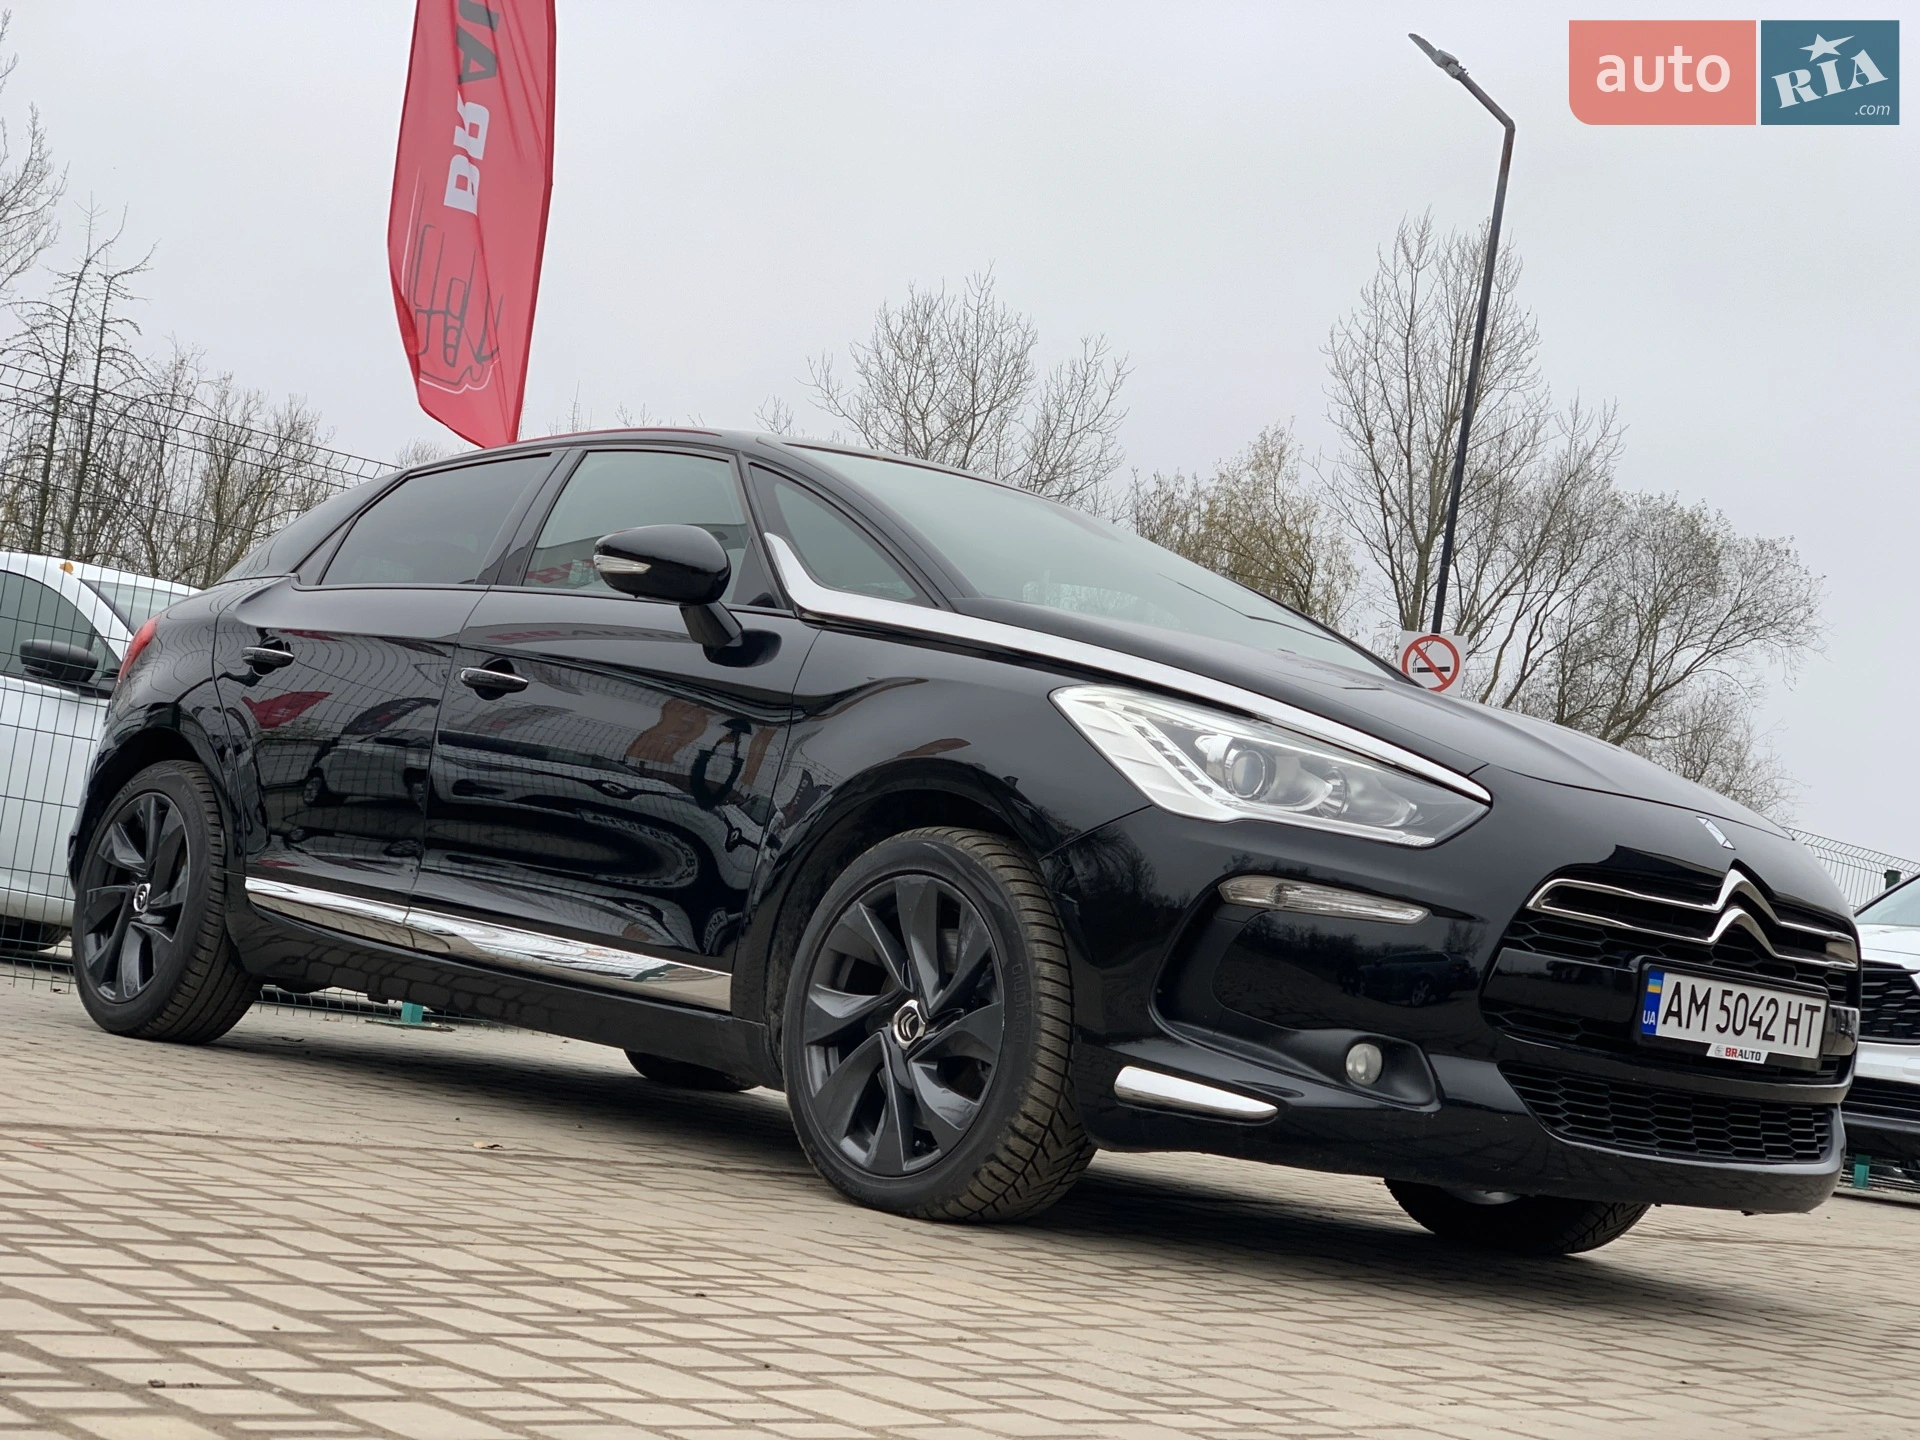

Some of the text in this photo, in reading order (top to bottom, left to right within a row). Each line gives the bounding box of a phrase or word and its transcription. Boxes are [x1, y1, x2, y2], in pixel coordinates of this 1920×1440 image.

[1642, 1009, 1656, 1025] UA
[1661, 981, 1822, 1048] AM 5042 HT
[1724, 1047, 1762, 1062] BRAUTO
